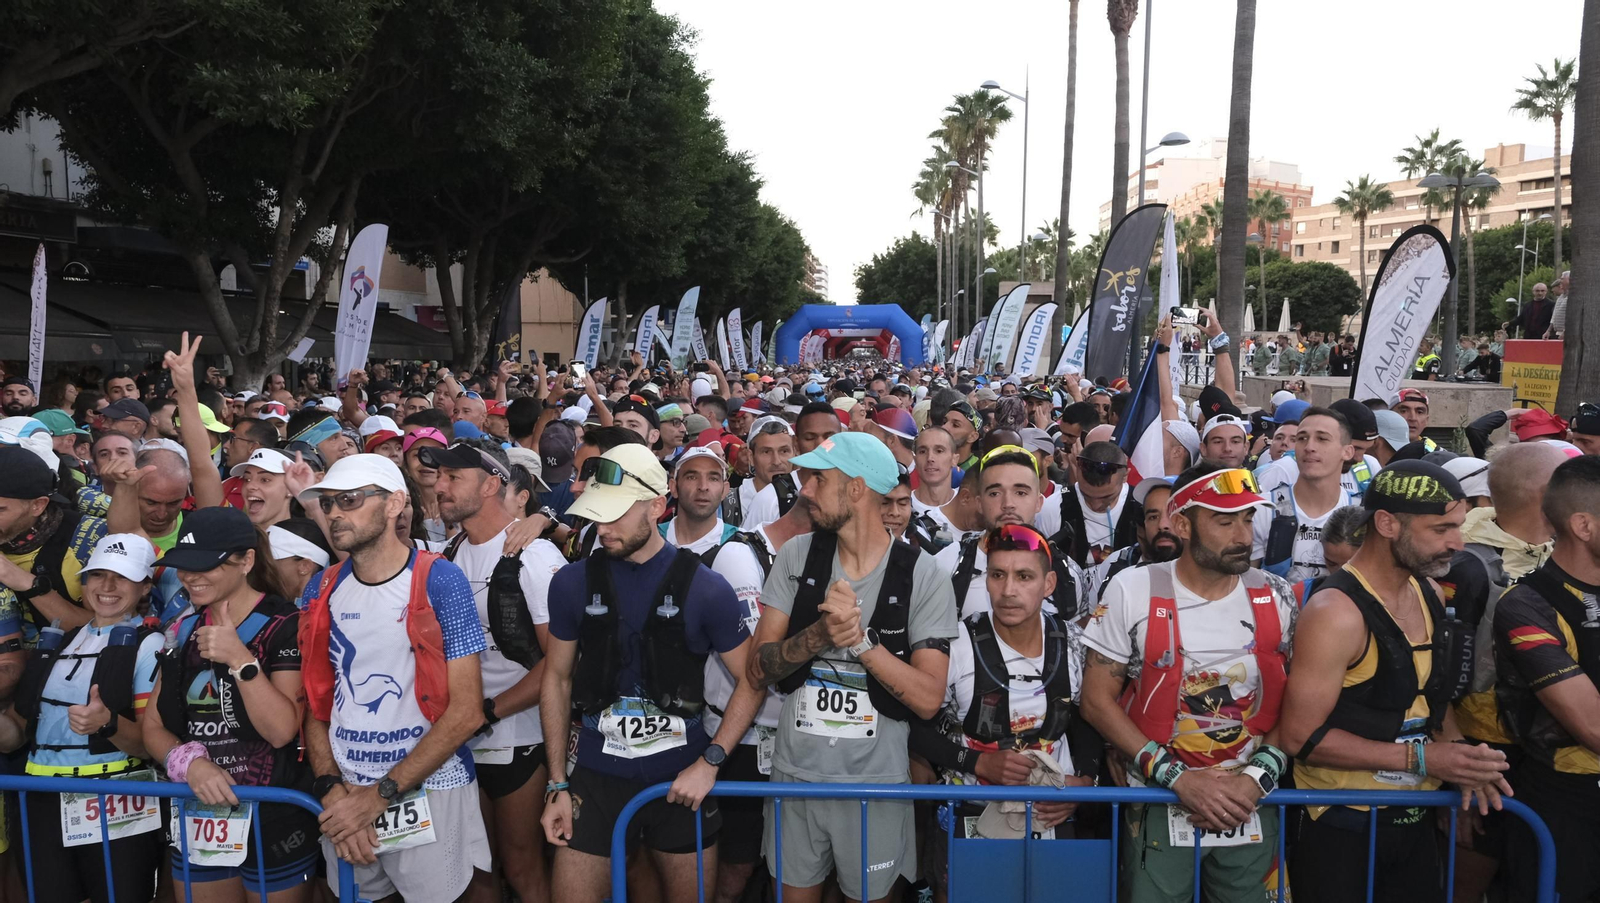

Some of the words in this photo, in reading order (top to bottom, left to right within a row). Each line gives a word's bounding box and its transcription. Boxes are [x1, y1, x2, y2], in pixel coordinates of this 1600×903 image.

[1110, 265, 1141, 332] sabores
[1021, 309, 1048, 374] HYUNDAI
[1374, 276, 1431, 384] ALMERÍA
[1385, 335, 1415, 392] CIUDAD
[1511, 366, 1521, 378] LA
[816, 688, 858, 714] 805
[335, 725, 424, 744] ULTRAFONDO
[617, 716, 672, 739] 1252
[85, 794, 146, 821] 5410
[374, 801, 419, 832] 475
[67, 833, 88, 841] asisa
[193, 818, 229, 843] 703
[387, 823, 421, 836] ULTRAFONDO
[869, 859, 895, 872] TERREX
